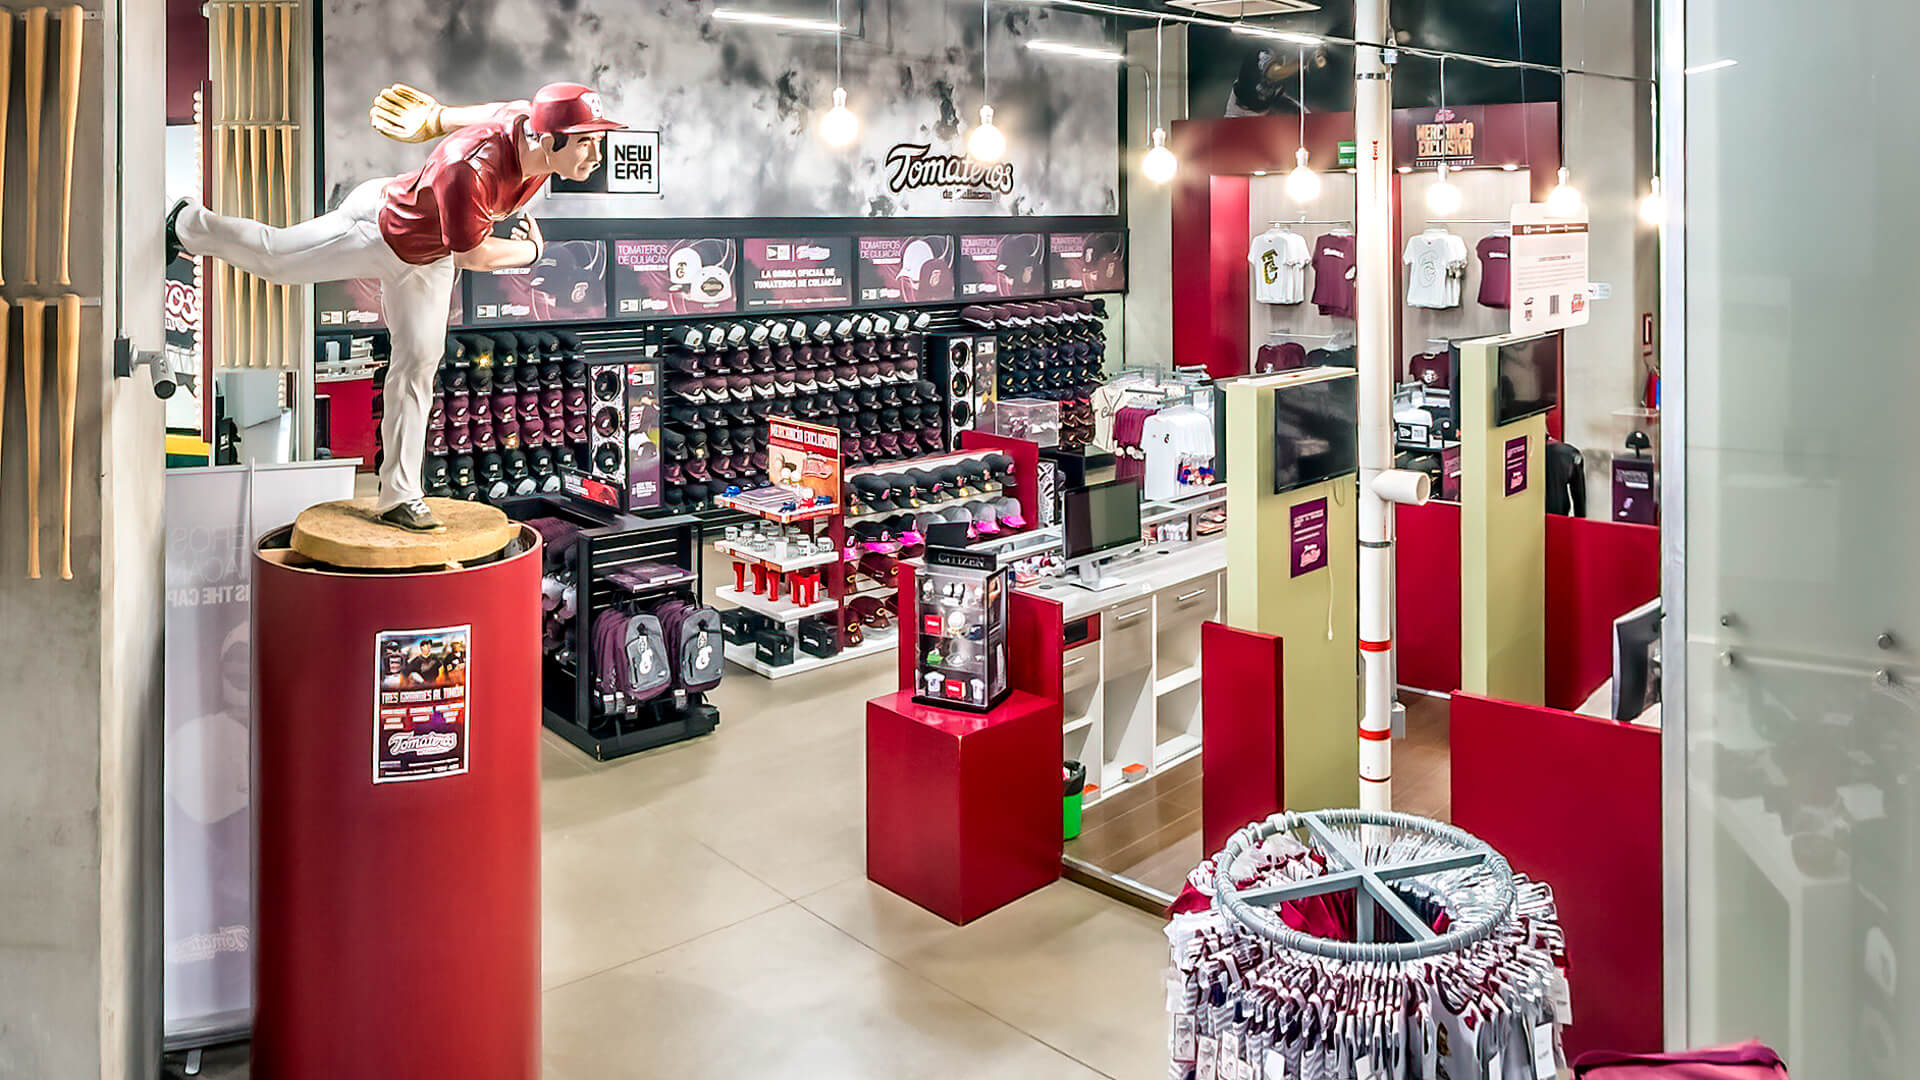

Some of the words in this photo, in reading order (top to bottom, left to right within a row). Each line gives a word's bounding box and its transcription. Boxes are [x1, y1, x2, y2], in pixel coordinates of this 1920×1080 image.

[614, 145, 652, 162] NEW
[614, 163, 652, 180] ERA
[885, 143, 1014, 195] Tomateros
[618, 244, 668, 255] TOMATEROS
[937, 552, 985, 568] CITIZEN
[388, 731, 457, 755] Tomateros
